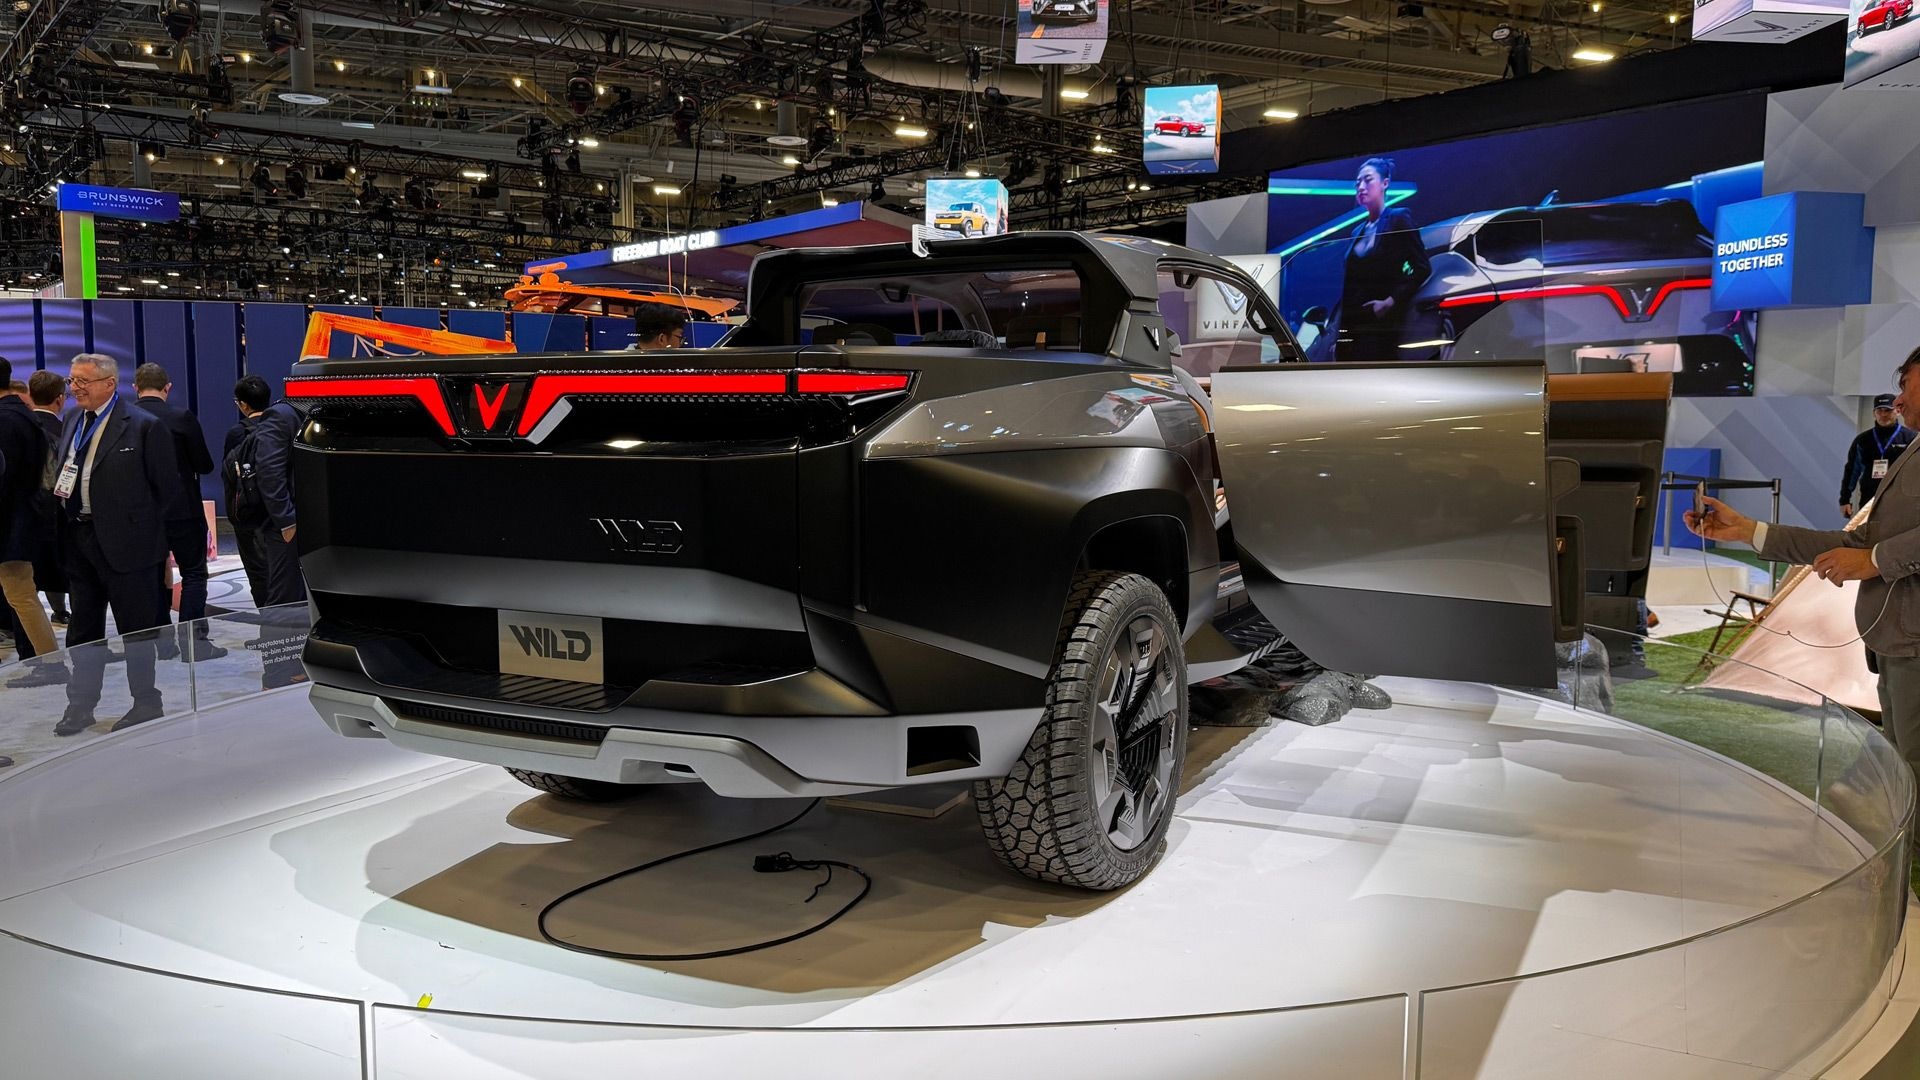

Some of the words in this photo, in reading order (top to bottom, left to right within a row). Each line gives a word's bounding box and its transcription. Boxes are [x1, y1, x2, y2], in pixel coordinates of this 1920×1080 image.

[77, 191, 164, 207] BRUNSWICK
[613, 241, 658, 262] FREEDOM
[660, 235, 687, 255] BOAT
[688, 231, 716, 250] CLUB
[1717, 233, 1789, 257] BOUNDLESS
[1720, 253, 1784, 274] TOGETHER
[508, 624, 592, 662] WILD
